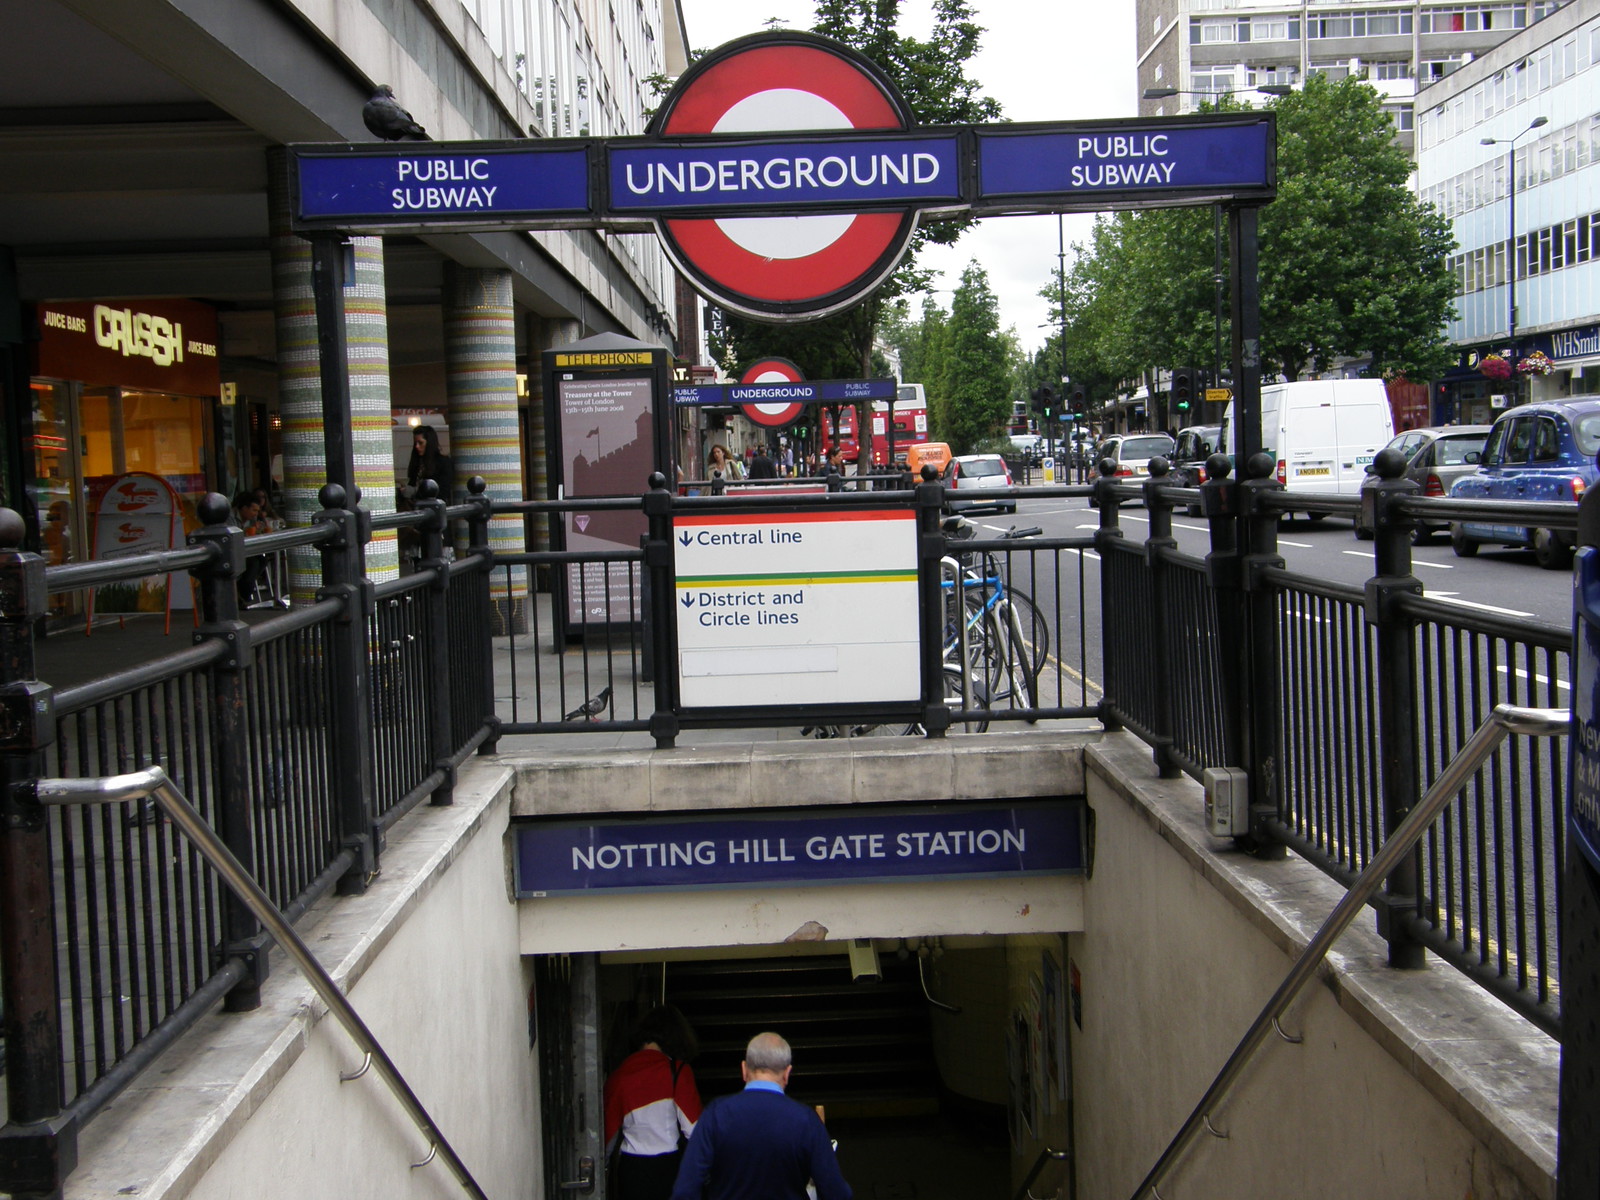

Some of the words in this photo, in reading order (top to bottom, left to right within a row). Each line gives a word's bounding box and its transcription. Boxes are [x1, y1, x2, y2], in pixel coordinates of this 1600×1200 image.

[1079, 134, 1169, 159] PUBLIC
[398, 158, 490, 182] PUBLIC
[626, 152, 940, 195] UNDERGROUND
[1071, 161, 1177, 187] SUBWAY
[391, 186, 498, 210] SUBWAY
[44, 311, 66, 330] JUICE
[66, 315, 87, 333] BARS
[94, 304, 184, 366] CRUSSH
[187, 340, 203, 355] JUICE
[202, 343, 217, 357] BARS
[564, 352, 643, 366] TELEPHONE
[674, 388, 698, 396] PUBLIC
[732, 387, 813, 399] UNDERGROUND
[844, 389, 871, 397] SUBWAY
[845, 382, 870, 390] PUBLIC
[584, 398, 592, 406] of
[675, 395, 700, 403] UBWAY
[594, 405, 609, 413] June
[609, 404, 624, 412] 2008
[696, 529, 764, 546] Central
[770, 529, 803, 545] line
[698, 592, 766, 607] District
[772, 590, 804, 605] and
[699, 611, 750, 627] Circle
[757, 610, 799, 625] lines
[572, 841, 716, 870] NOTTING
[728, 838, 796, 864] HILL
[805, 834, 886, 861] GATE
[896, 829, 1025, 857] STATION
